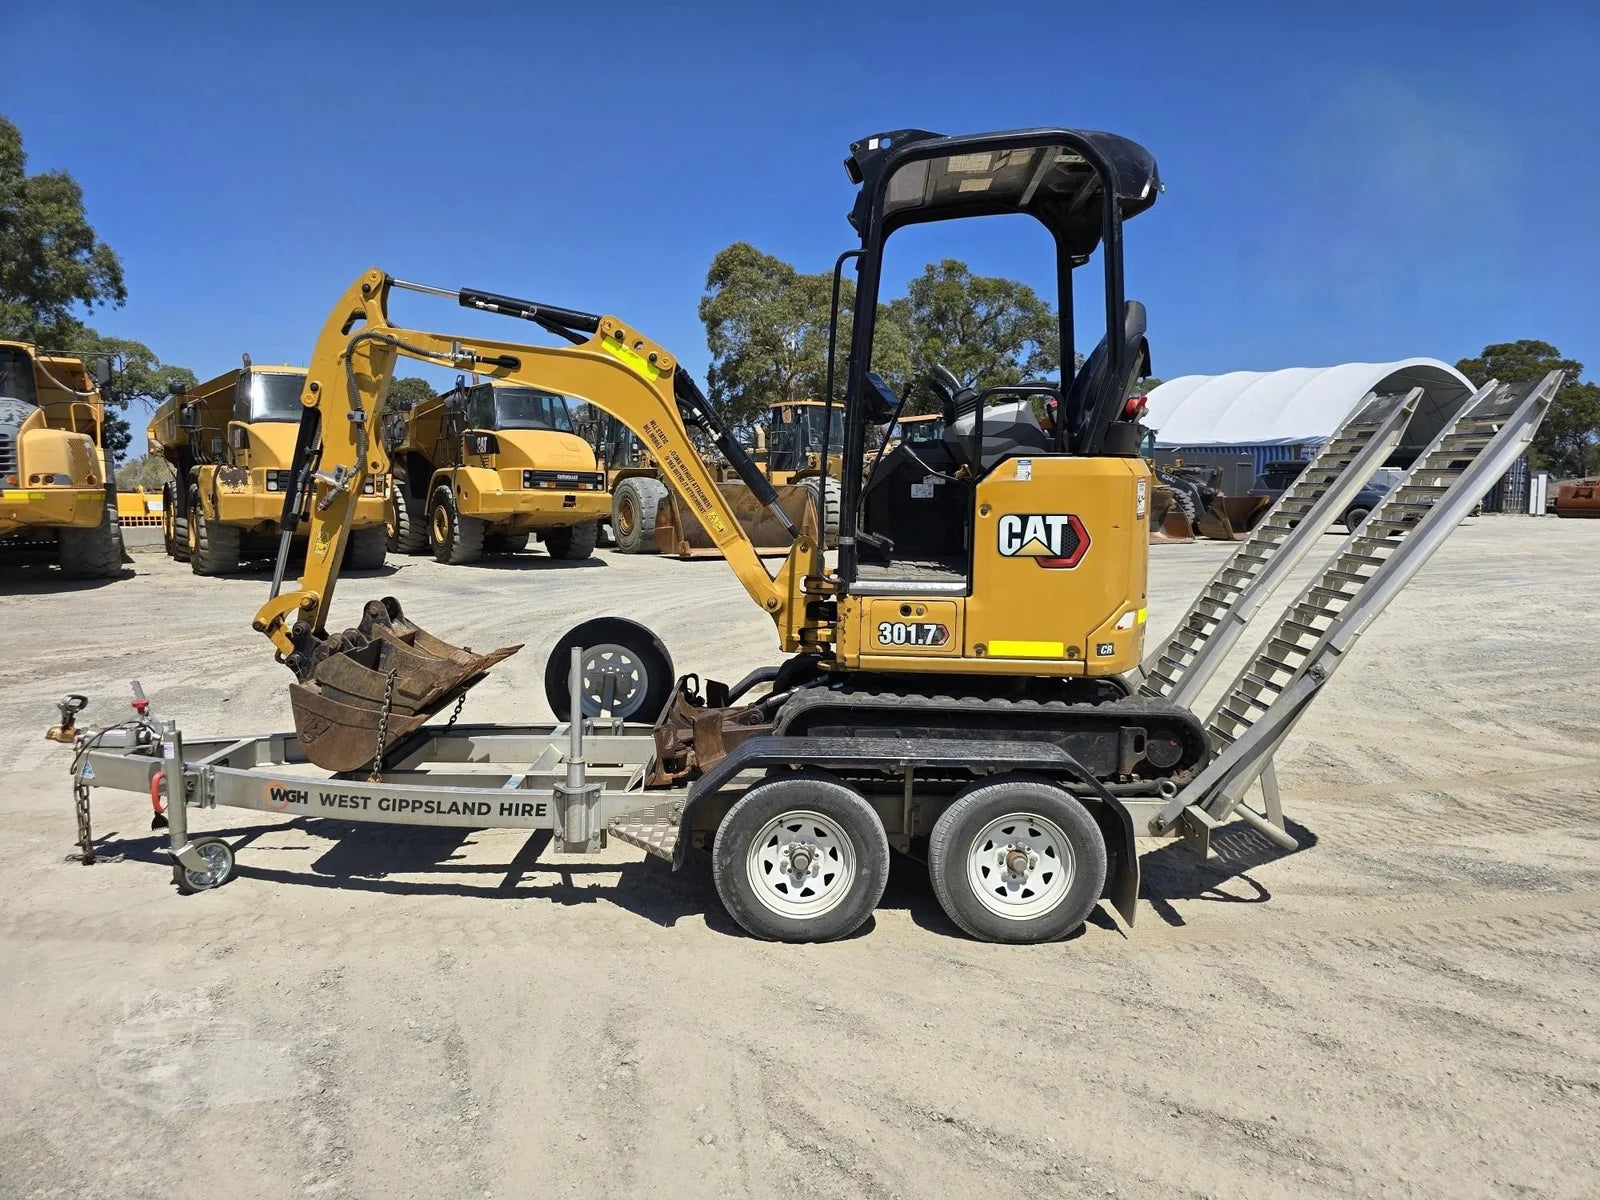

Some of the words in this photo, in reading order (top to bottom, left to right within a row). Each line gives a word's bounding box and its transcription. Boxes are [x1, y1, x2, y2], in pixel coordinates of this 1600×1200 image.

[649, 432, 663, 450] MOBILE
[685, 485, 706, 514] ATTACHMENT
[656, 427, 669, 445] STATIC
[680, 462, 695, 482] WITHOUT
[691, 481, 713, 509] ATTACHMENT
[999, 515, 1068, 557] CAT
[878, 623, 937, 645] 301.7
[1100, 644, 1114, 655] CR
[270, 787, 309, 805] WGH
[319, 792, 371, 810] WEST
[377, 797, 492, 817] GIPPSLAND
[499, 802, 548, 817] HIRE
